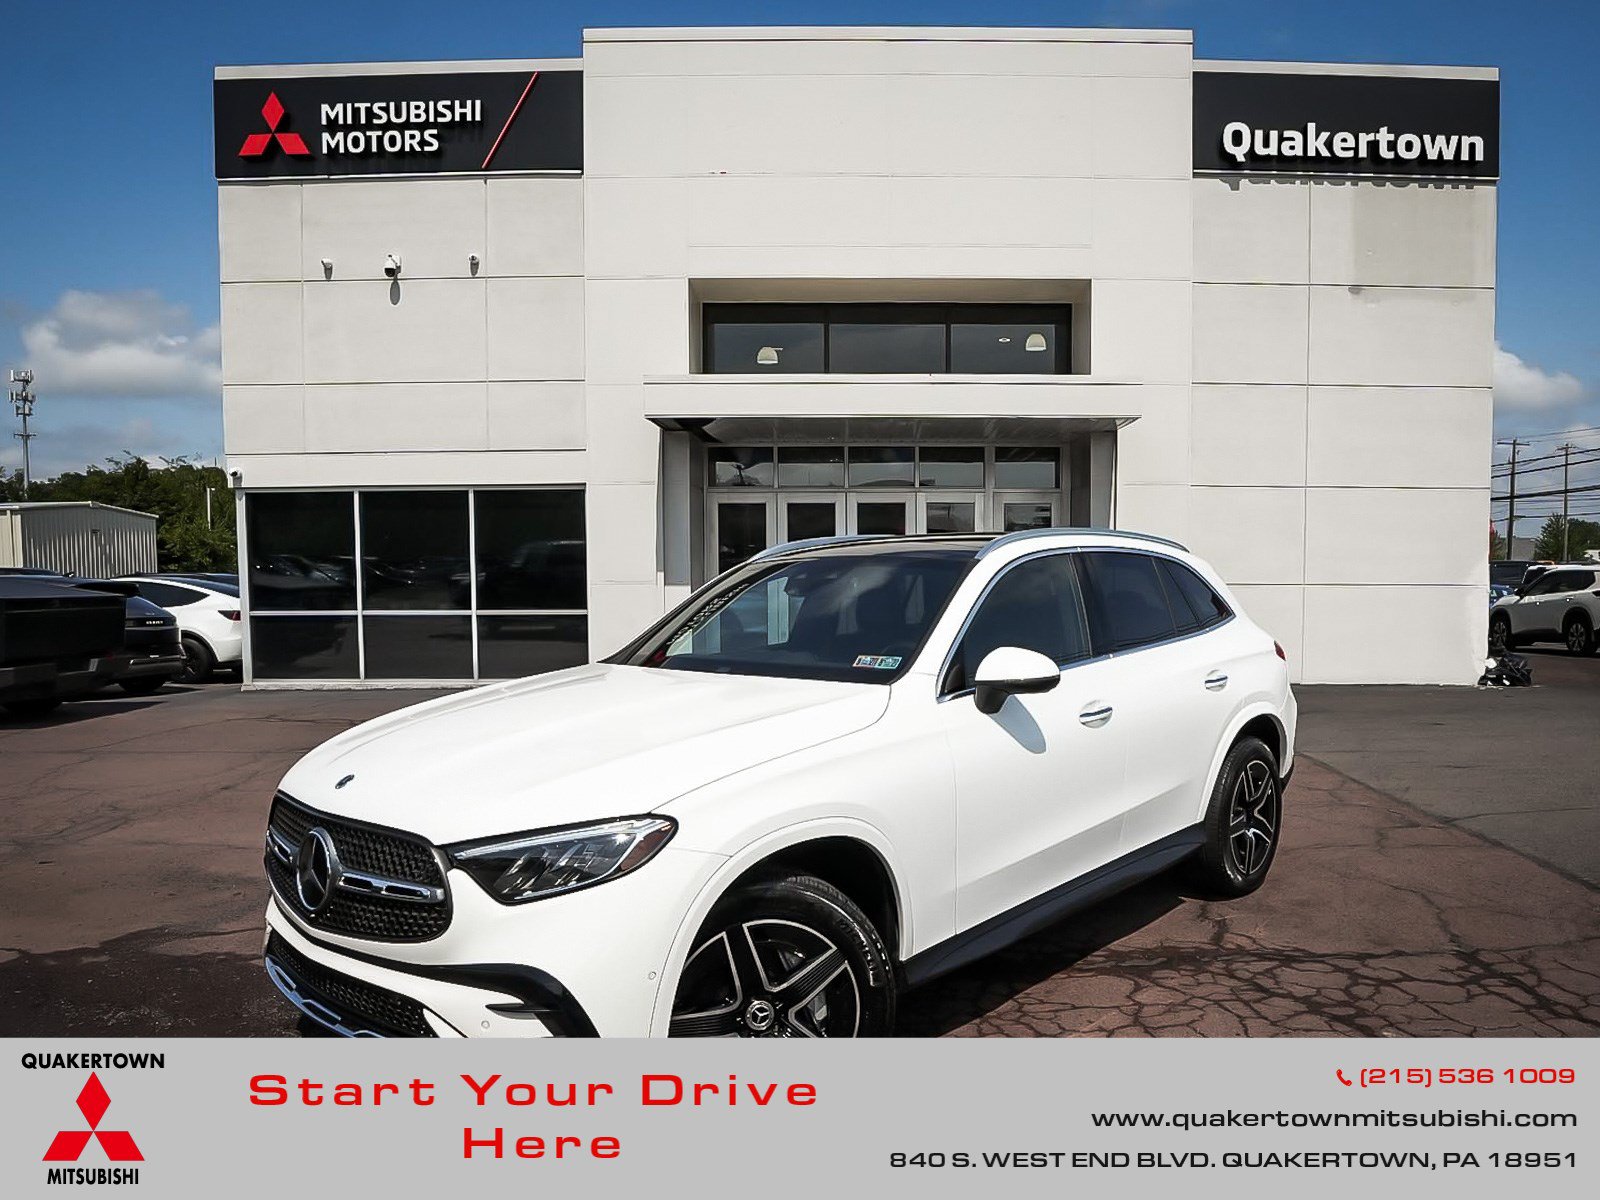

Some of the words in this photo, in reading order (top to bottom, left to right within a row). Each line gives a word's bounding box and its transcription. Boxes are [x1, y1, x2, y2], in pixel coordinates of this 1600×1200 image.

[320, 99, 482, 126] MITSUBISHI
[321, 128, 439, 155] MOTORS
[1222, 121, 1484, 163] Quakertown
